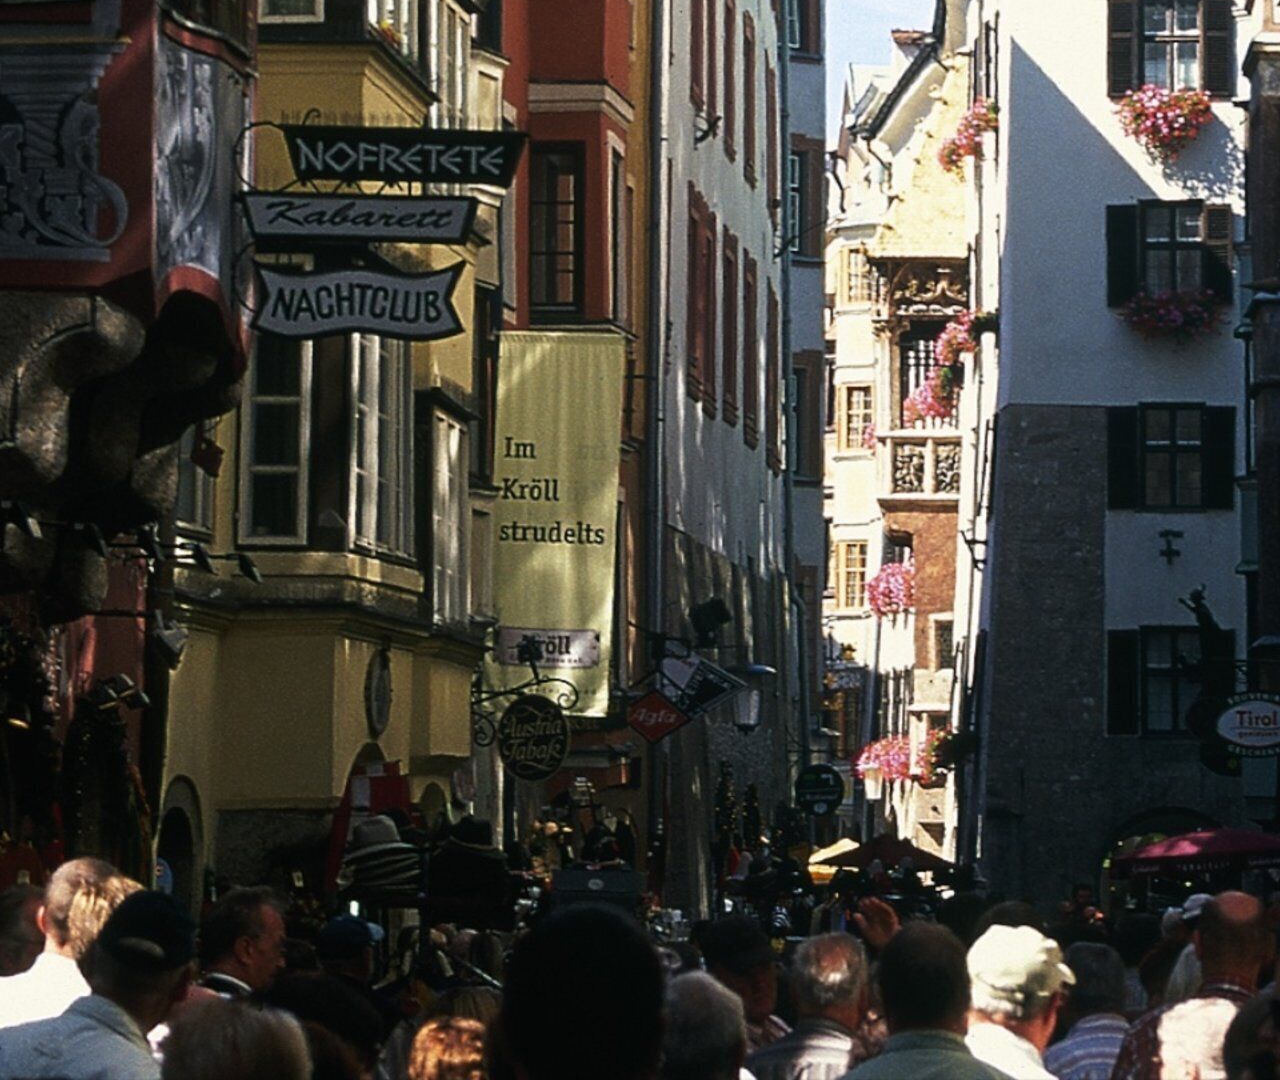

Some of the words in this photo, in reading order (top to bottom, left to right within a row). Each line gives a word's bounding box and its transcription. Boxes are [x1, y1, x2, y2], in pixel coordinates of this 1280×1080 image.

[296, 137, 505, 176] NOFRETETE
[267, 199, 453, 230] Kabarett
[271, 283, 444, 323] NACHTCLUB
[504, 437, 537, 459] Im
[502, 478, 560, 502] Kröll
[499, 521, 606, 545] strudelts
[503, 716, 562, 738] Austria
[634, 708, 677, 725] Agfa
[1236, 710, 1278, 727] Tirol
[503, 738, 562, 761] Tabak
